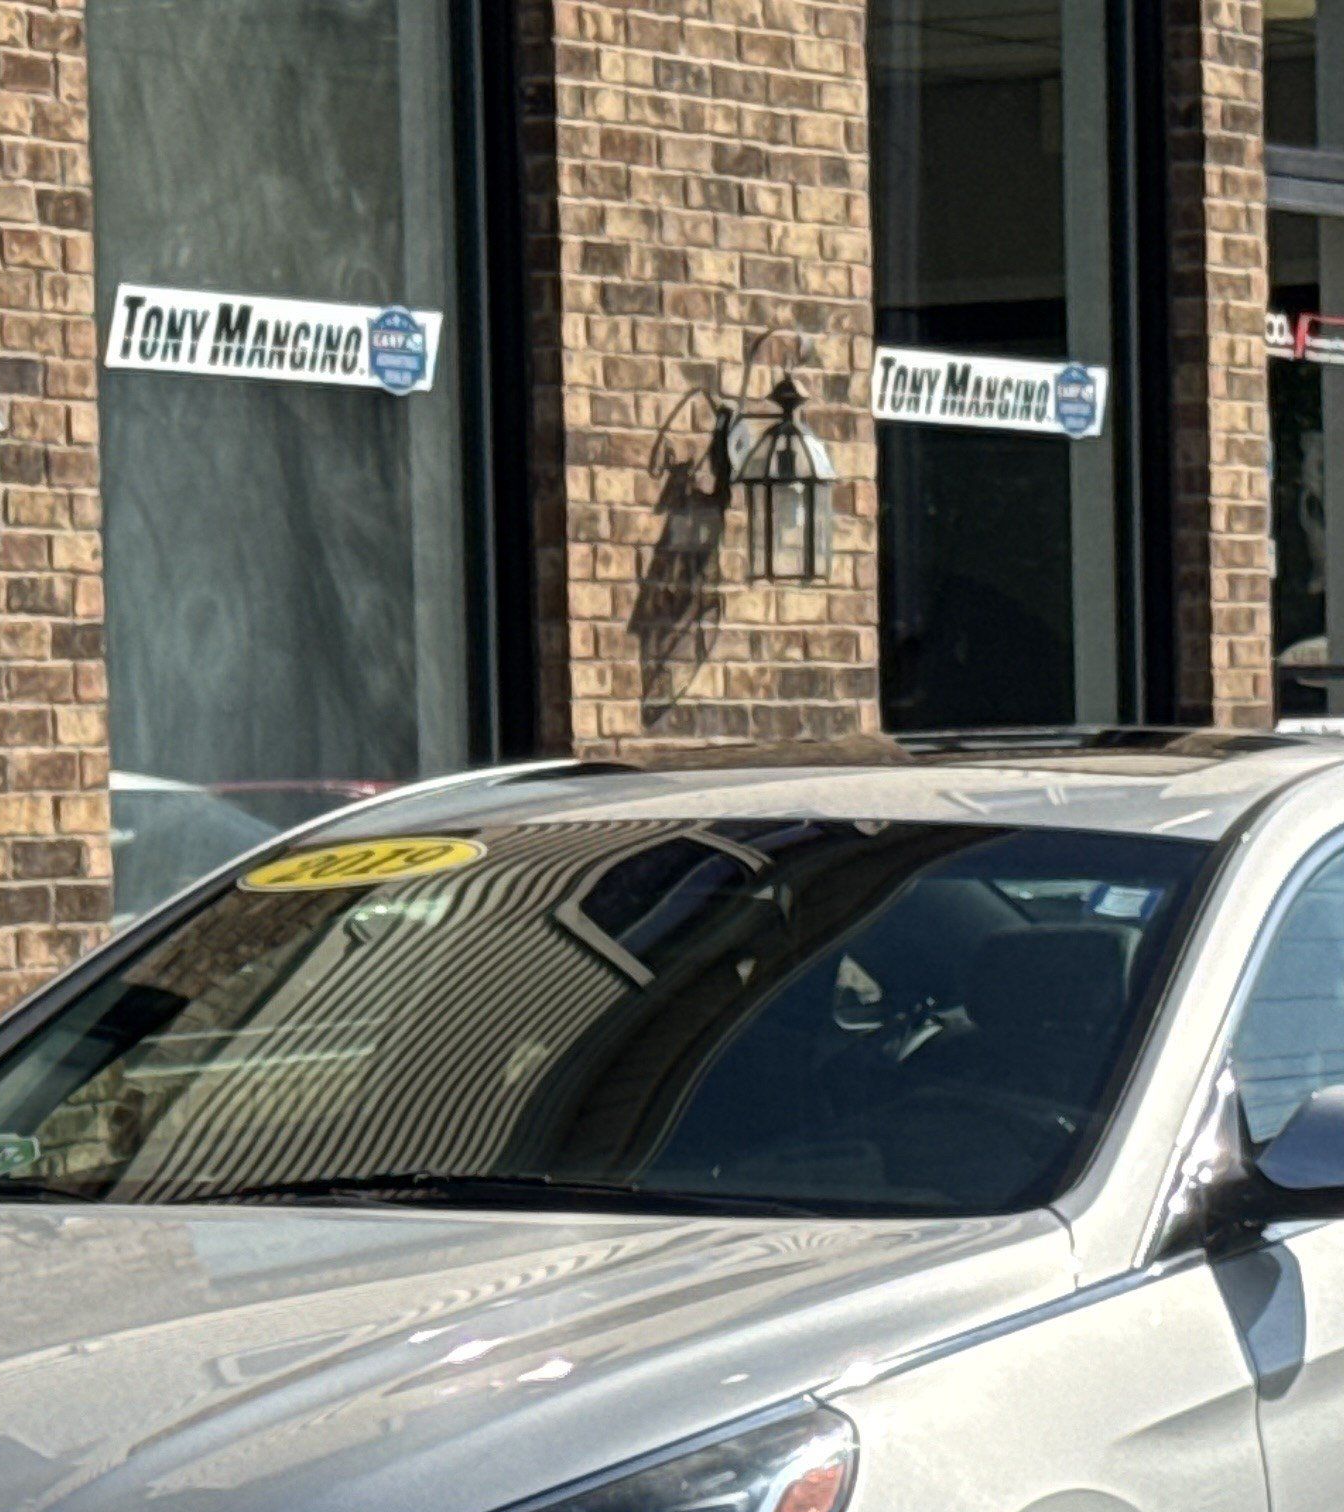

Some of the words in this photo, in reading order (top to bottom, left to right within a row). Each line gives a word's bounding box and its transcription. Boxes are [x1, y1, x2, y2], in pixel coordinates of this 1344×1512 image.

[119, 295, 210, 364] TONY
[878, 356, 941, 415] TONY
[266, 844, 455, 884] 2019
